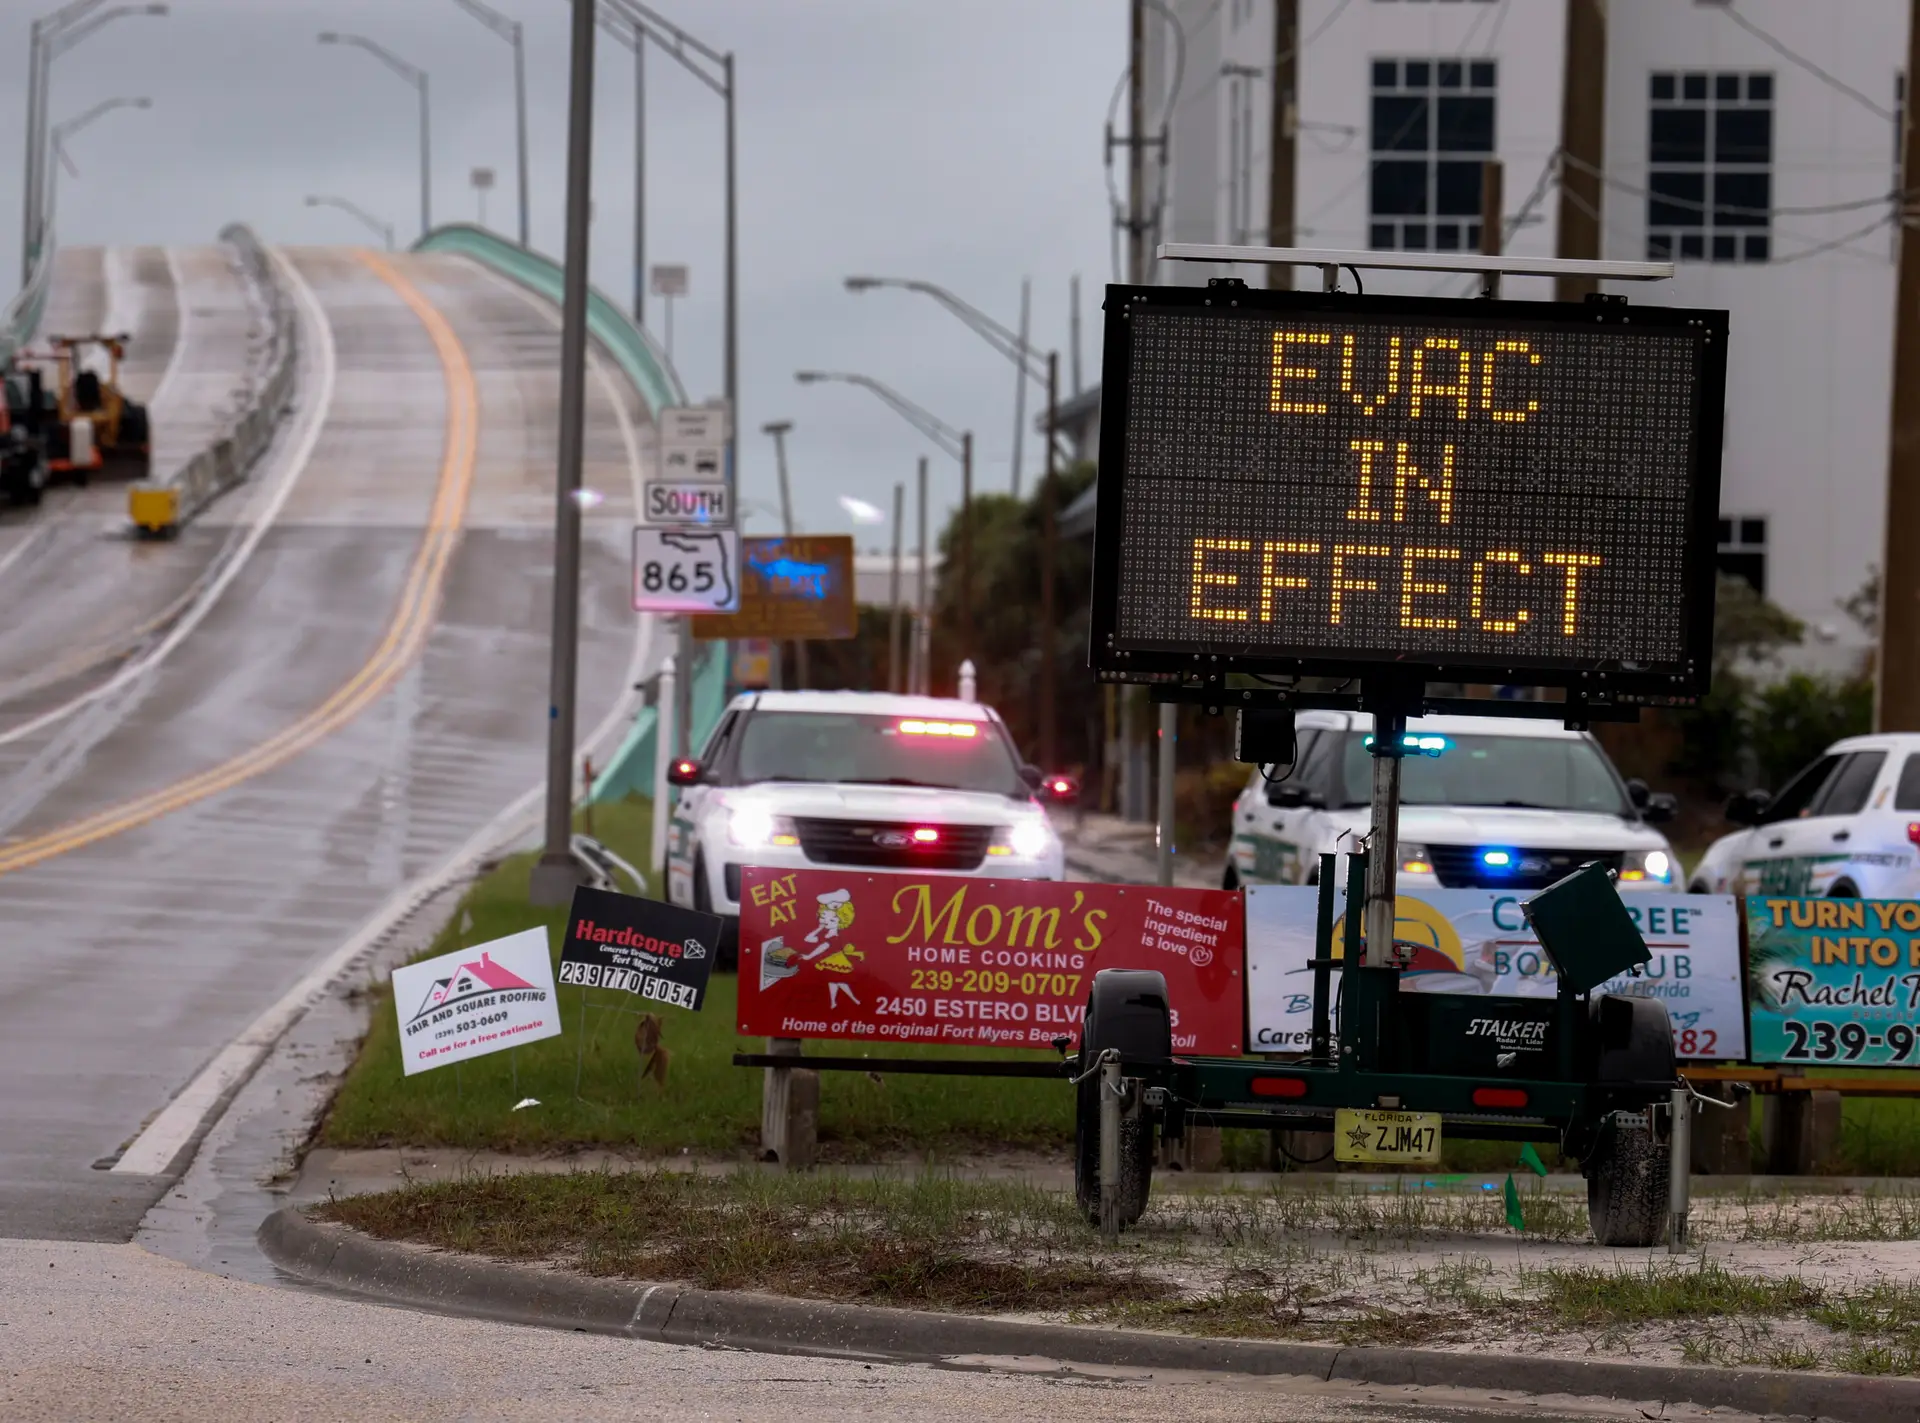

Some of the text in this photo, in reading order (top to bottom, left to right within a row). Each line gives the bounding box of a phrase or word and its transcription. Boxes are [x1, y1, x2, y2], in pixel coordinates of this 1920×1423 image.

[1270, 331, 1541, 422] EVAC
[1347, 440, 1454, 524] IN
[651, 488, 723, 515] SOUTH
[642, 561, 714, 593] 865
[1191, 537, 1601, 636] EFFECT
[751, 873, 797, 906] EAT
[770, 899, 797, 928] AT
[886, 884, 1108, 951] Mom's
[1146, 899, 1228, 932] The special
[1766, 900, 1865, 929] TURN
[575, 919, 684, 959] Hardcore
[1141, 933, 1187, 955] is love
[1144, 917, 1218, 946] ingredient
[599, 944, 629, 956] Concrete
[658, 957, 677, 968] LLC
[612, 954, 659, 973] Fort Myers
[908, 947, 1085, 969] HOME COOKING
[1811, 935, 1899, 967] INTO
[911, 969, 1082, 996] 239-209-0707
[1633, 980, 1690, 998] Florida
[1773, 970, 1896, 1006] Rachel
[406, 992, 547, 1037] FAIR AND SQUARE ROOFING
[875, 996, 927, 1017] 2450
[934, 998, 1028, 1021] ESTERO
[1036, 1003, 1087, 1024] BLV
[419, 1047, 438, 1059] Call
[440, 1045, 451, 1054] us
[454, 1041, 467, 1051] for
[478, 1033, 498, 1043] free
[500, 1020, 543, 1037] estimate
[435, 1011, 509, 1040] (239) 503-0609
[782, 1017, 827, 1033] Home
[831, 1020, 849, 1033] of
[851, 1020, 876, 1035] the
[879, 1022, 938, 1038] original
[942, 1024, 974, 1038] Fort
[978, 1026, 1024, 1043] Myers
[1465, 1018, 1545, 1039] STALKER
[1364, 1113, 1413, 1123] FLORIDA
[1375, 1126, 1435, 1153] ZJM47
